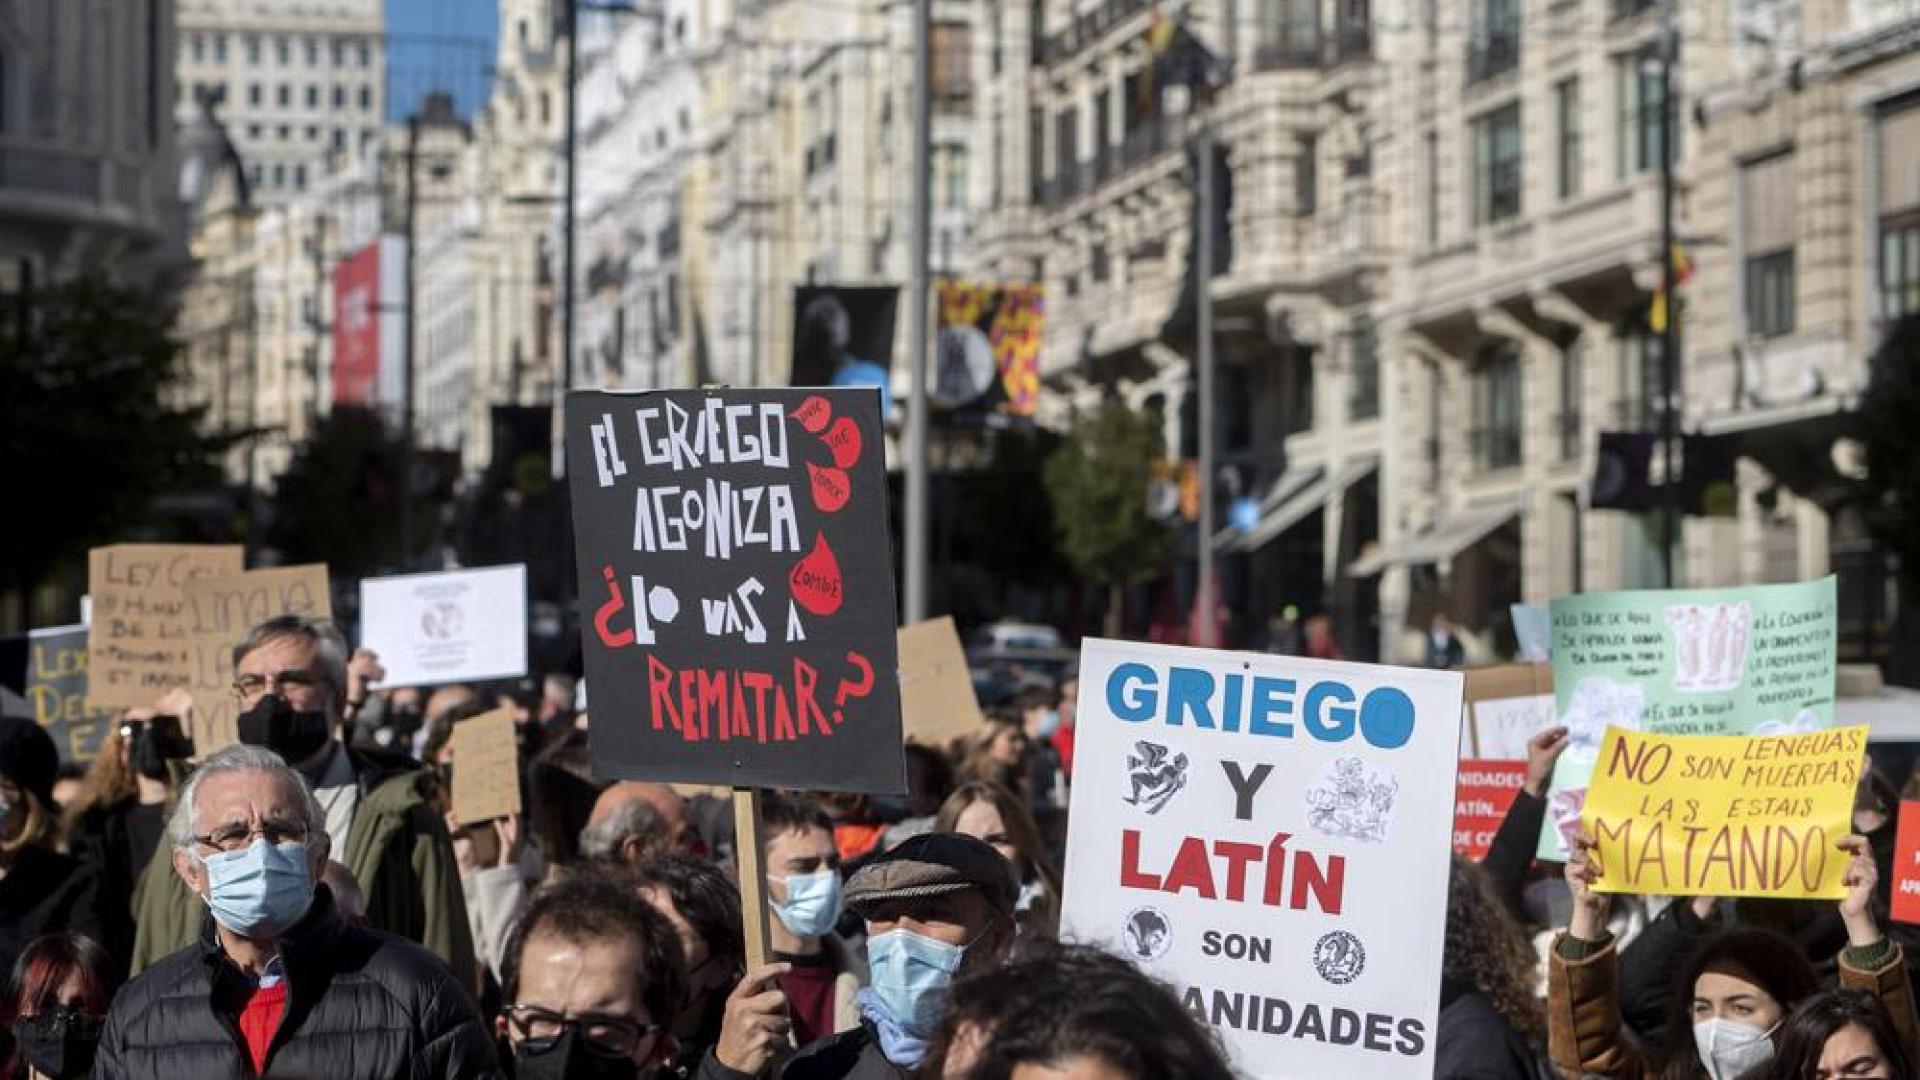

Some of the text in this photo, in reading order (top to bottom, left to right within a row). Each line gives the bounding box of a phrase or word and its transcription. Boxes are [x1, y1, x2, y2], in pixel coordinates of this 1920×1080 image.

[590, 397, 790, 488] EL GRIEGO
[632, 478, 801, 561] AGONIZA
[701, 576, 767, 644] VAS
[786, 598, 807, 642] A
[648, 651, 875, 744] REMATAR?
[1105, 662, 1416, 750] GRIEGO
[1221, 760, 1275, 820] Y
[1458, 770, 1525, 788] NIDADES
[1608, 730, 1862, 786] NO SON LENGUAS
[1740, 759, 1857, 788] MUERTAS
[1639, 794, 1814, 824] LAS ESTAIS
[1120, 829, 1345, 915] LATÍN
[1594, 816, 1828, 893] MATANDO
[1201, 931, 1273, 965] SON
[1184, 987, 1426, 1057] ANIDADES
